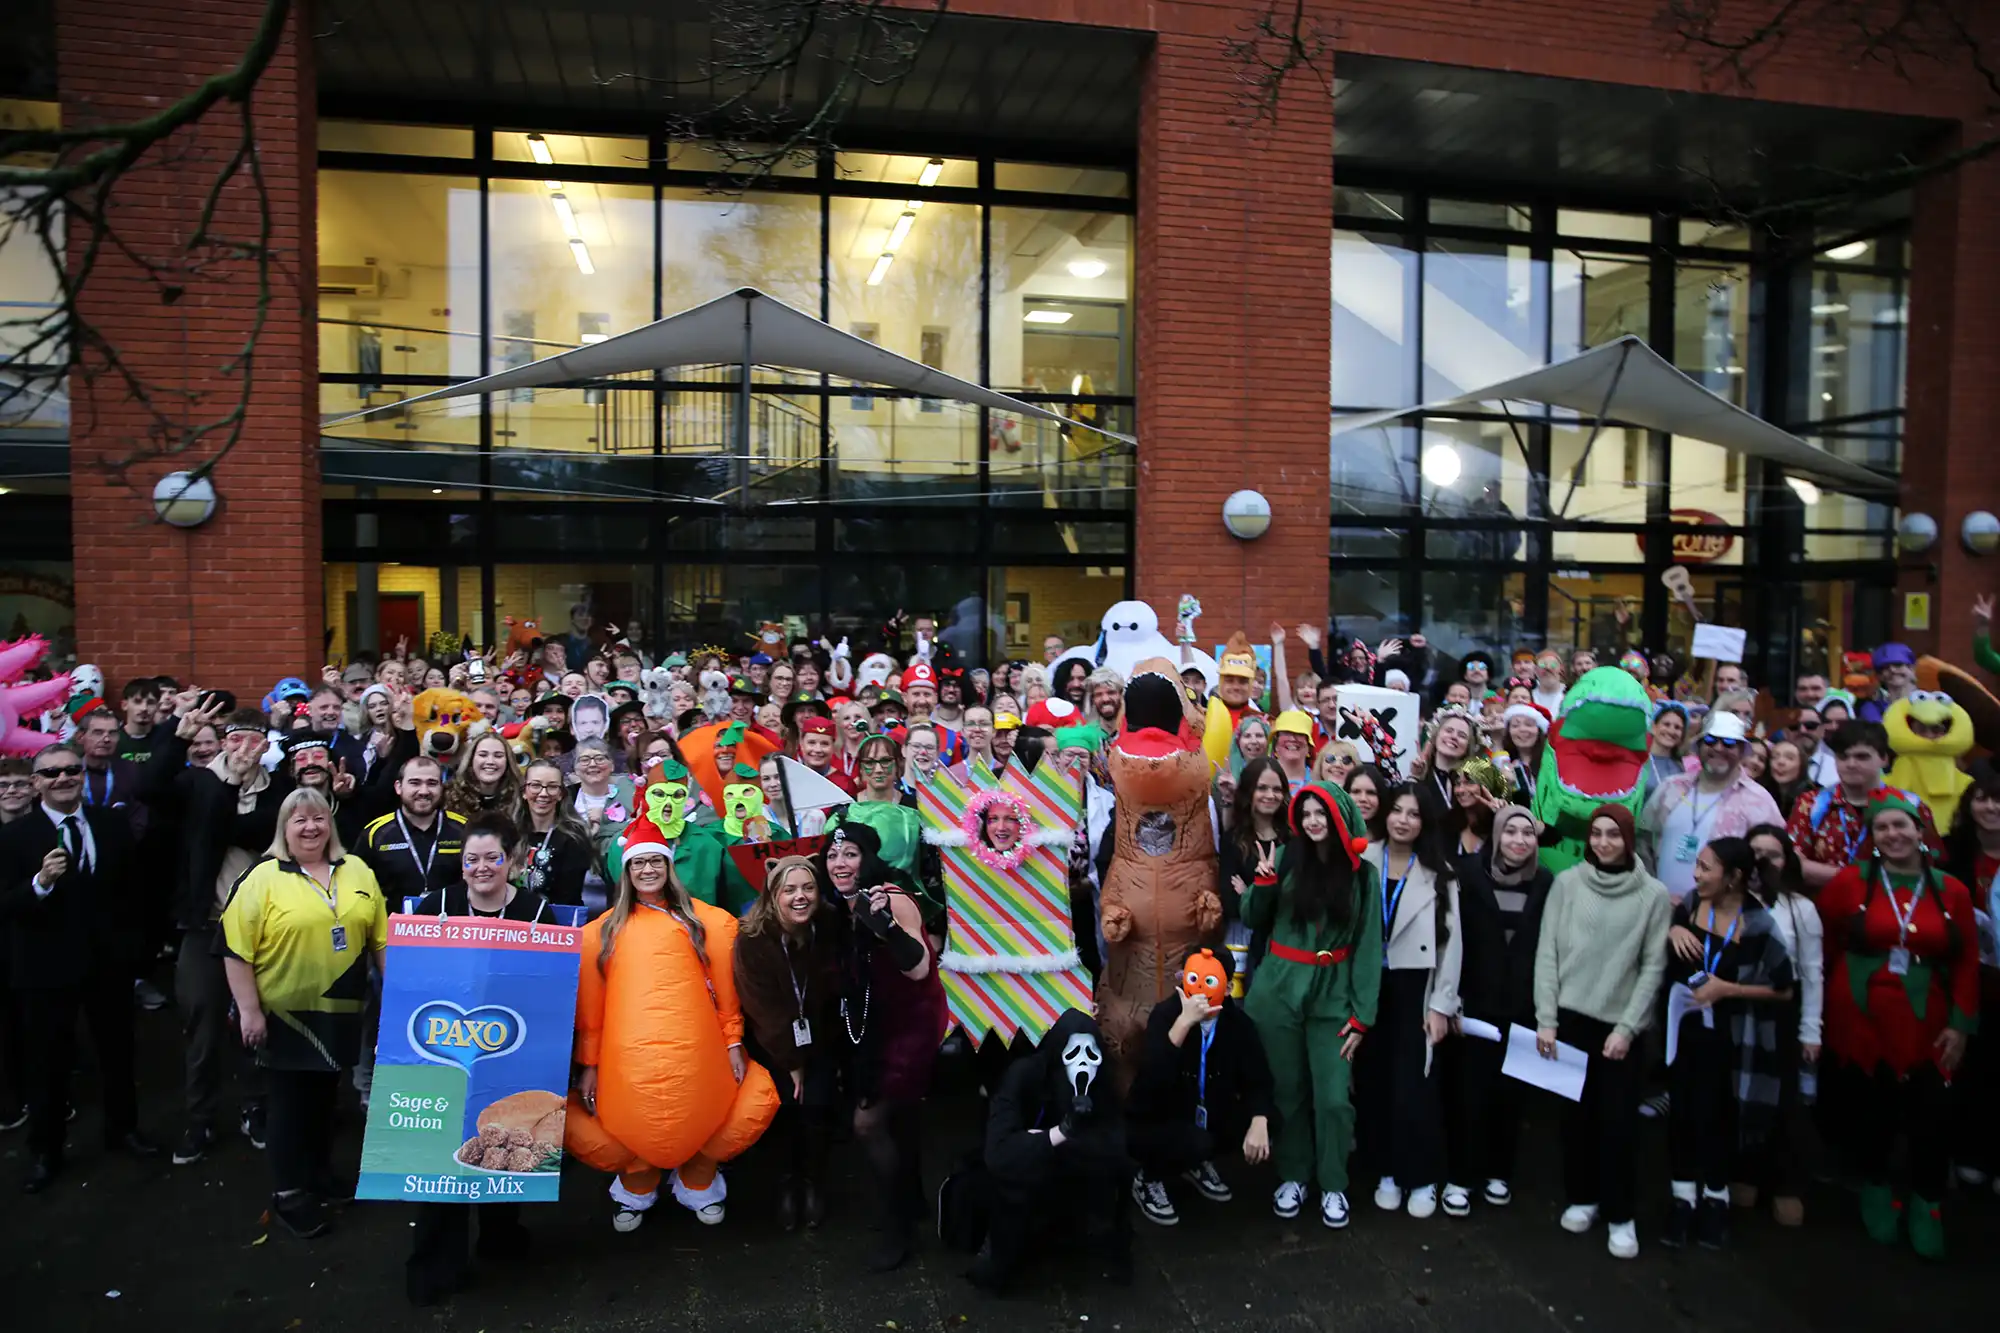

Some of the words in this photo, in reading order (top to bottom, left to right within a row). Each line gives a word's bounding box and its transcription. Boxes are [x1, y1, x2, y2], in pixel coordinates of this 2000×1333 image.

[394, 923, 441, 938] MAKES
[445, 926, 459, 939] 12
[462, 928, 528, 943] STUFFING
[532, 932, 574, 946] BALLS
[425, 1017, 508, 1051] PAXO
[389, 1092, 432, 1112] Sage
[434, 1097, 449, 1112] &
[389, 1112, 443, 1129] Onion
[404, 1175, 482, 1199] Stuffing
[486, 1176, 524, 1194] Mix
